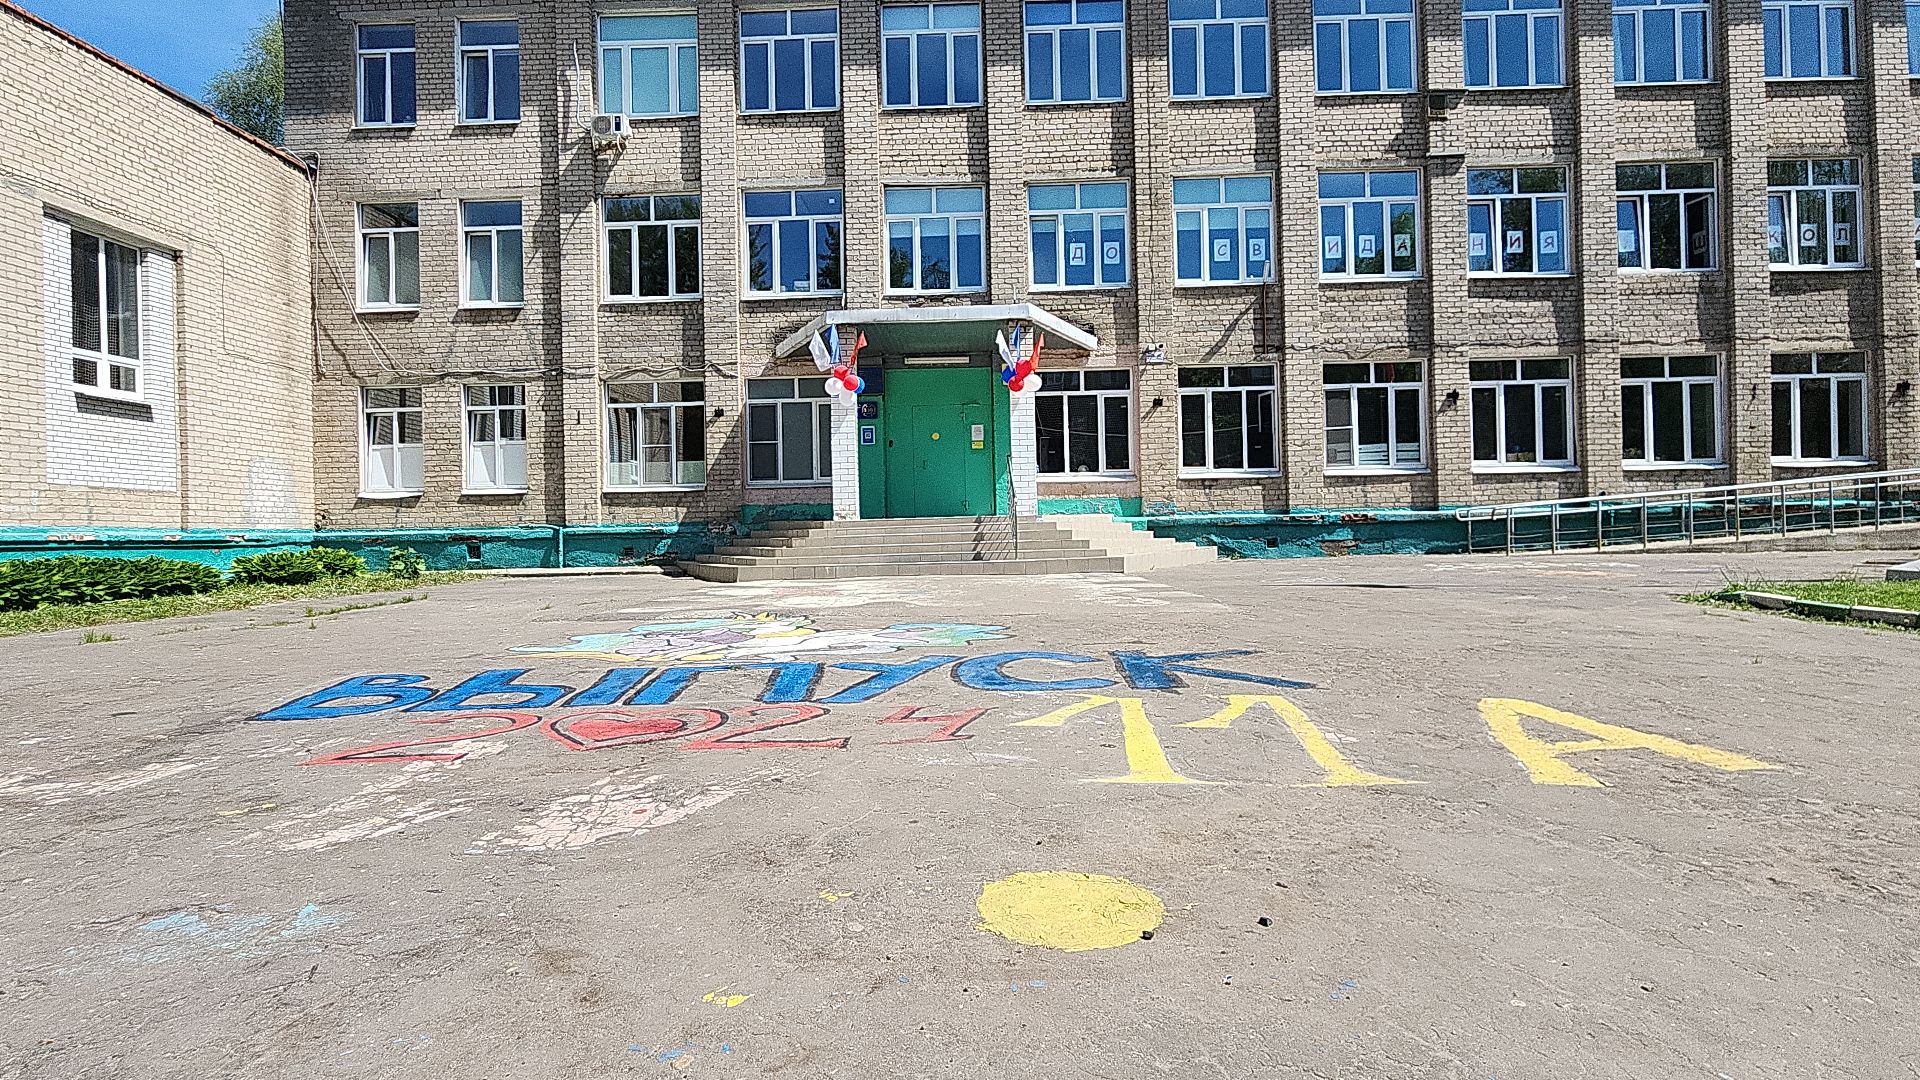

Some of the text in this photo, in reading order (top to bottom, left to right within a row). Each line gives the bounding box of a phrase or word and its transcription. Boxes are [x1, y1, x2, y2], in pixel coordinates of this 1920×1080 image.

[243, 649, 1318, 721] ВЫПУСК
[1010, 693, 1786, 787] 11 А
